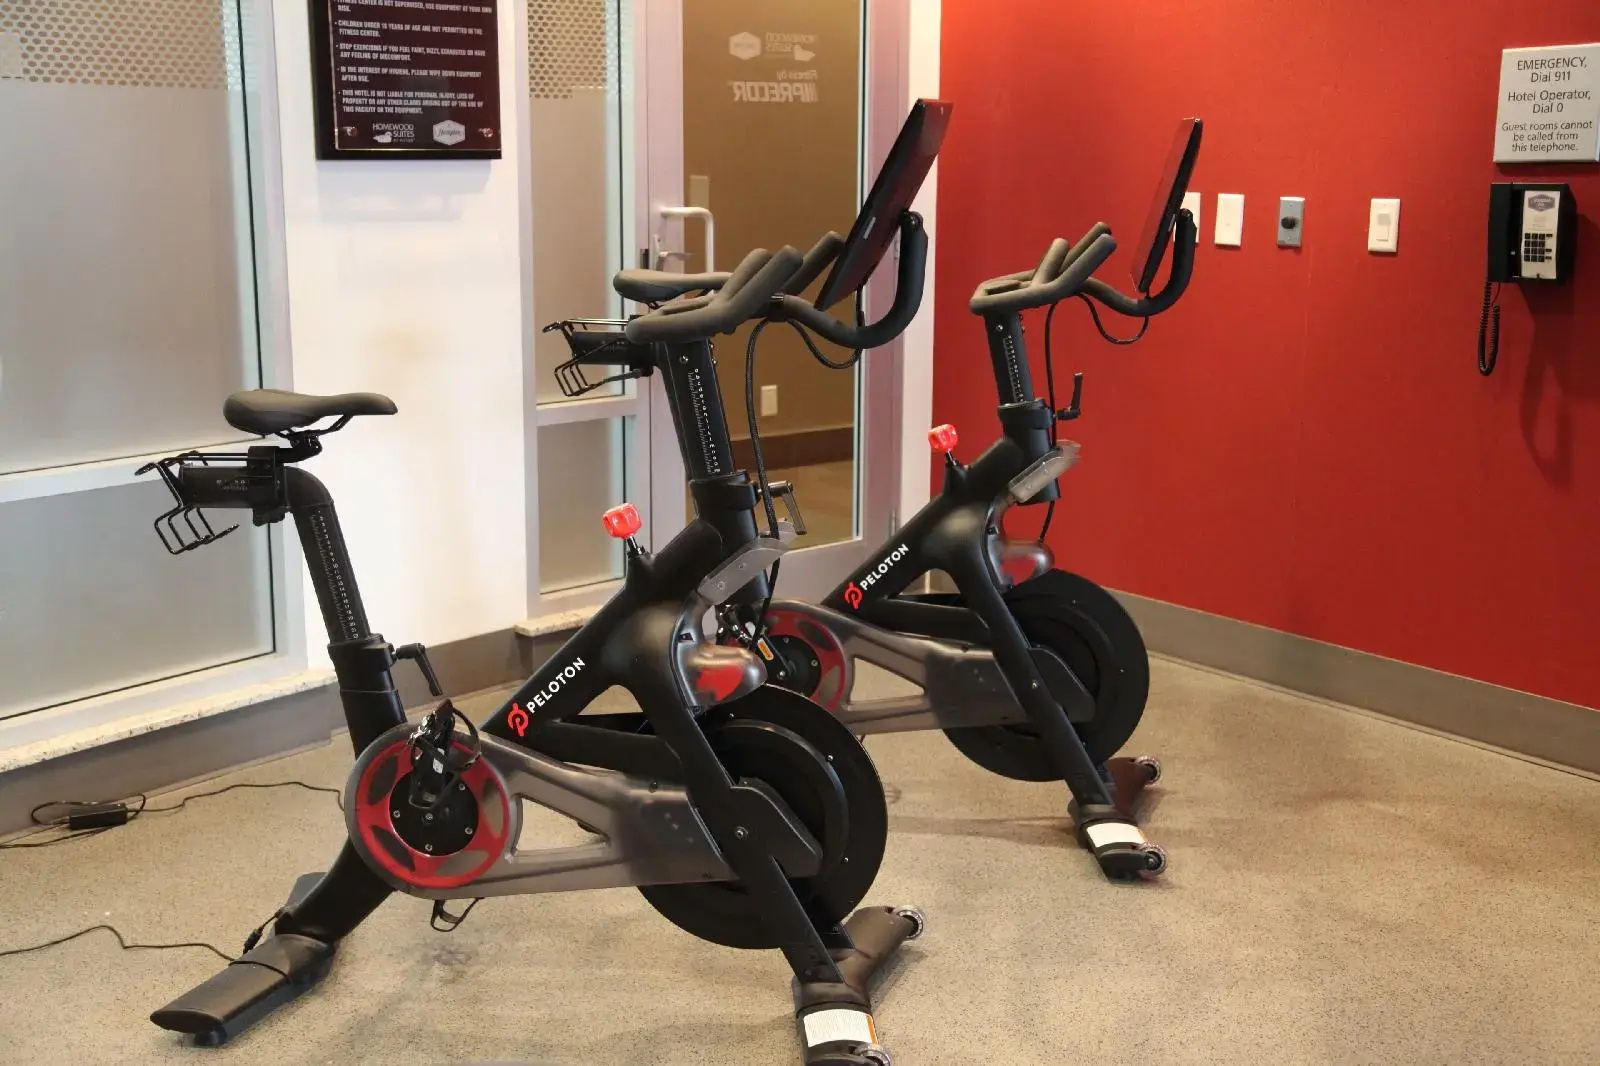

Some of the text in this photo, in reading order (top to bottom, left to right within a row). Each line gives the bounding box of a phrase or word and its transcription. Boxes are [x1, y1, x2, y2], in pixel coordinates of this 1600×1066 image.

[1517, 56, 1588, 71] EMERGENCY,
[1530, 70, 1571, 83] Dial 911
[1508, 89, 1591, 103] Hotel Operator,
[1532, 102, 1564, 114] Dial 0
[372, 123, 414, 131] HOMEWOOD
[1501, 120, 1593, 132] Guest rooms cannot
[393, 130, 415, 138] SUITES
[1513, 131, 1579, 141] be called from
[1511, 141, 1580, 153] this telephone.
[859, 543, 910, 591] PELOTON
[526, 656, 586, 714] PELOTON
